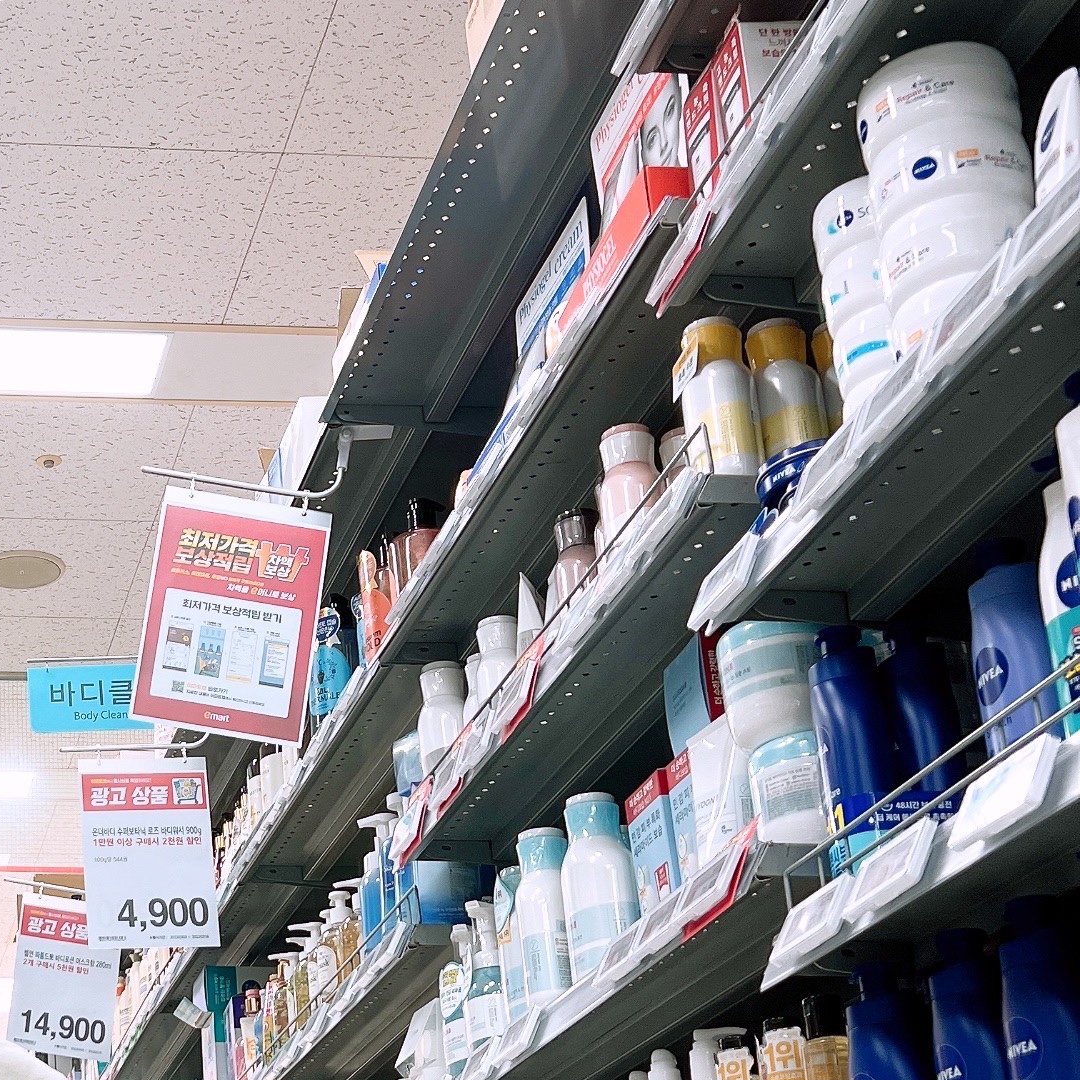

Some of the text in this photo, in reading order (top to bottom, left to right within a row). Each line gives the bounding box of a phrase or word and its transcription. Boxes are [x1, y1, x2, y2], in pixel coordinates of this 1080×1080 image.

[772, 463, 796, 484] NIVEA
[178, 527, 260, 558] 최저가격
[172, 545, 256, 575] 보상적립
[182, 598, 283, 624] 최저가격 보상적립 받기
[977, 664, 1004, 690] NIVEA
[73, 709, 98, 722] Body
[204, 711, 230, 723] emart
[90, 785, 169, 807] 광고 상품
[92, 835, 202, 847] 1만원 이상 구매시 2천원 할인
[147, 826, 159, 835] 로즈
[185, 825, 202, 836] 900g
[116, 896, 210, 933] 4,900
[26, 916, 56, 936] 광고
[22, 958, 90, 975] 2개 구매시 5천원 할인
[20, 1008, 106, 1044] 14,900
[764, 1038, 802, 1073] 1위
[1006, 1038, 1038, 1059] NIVEA
